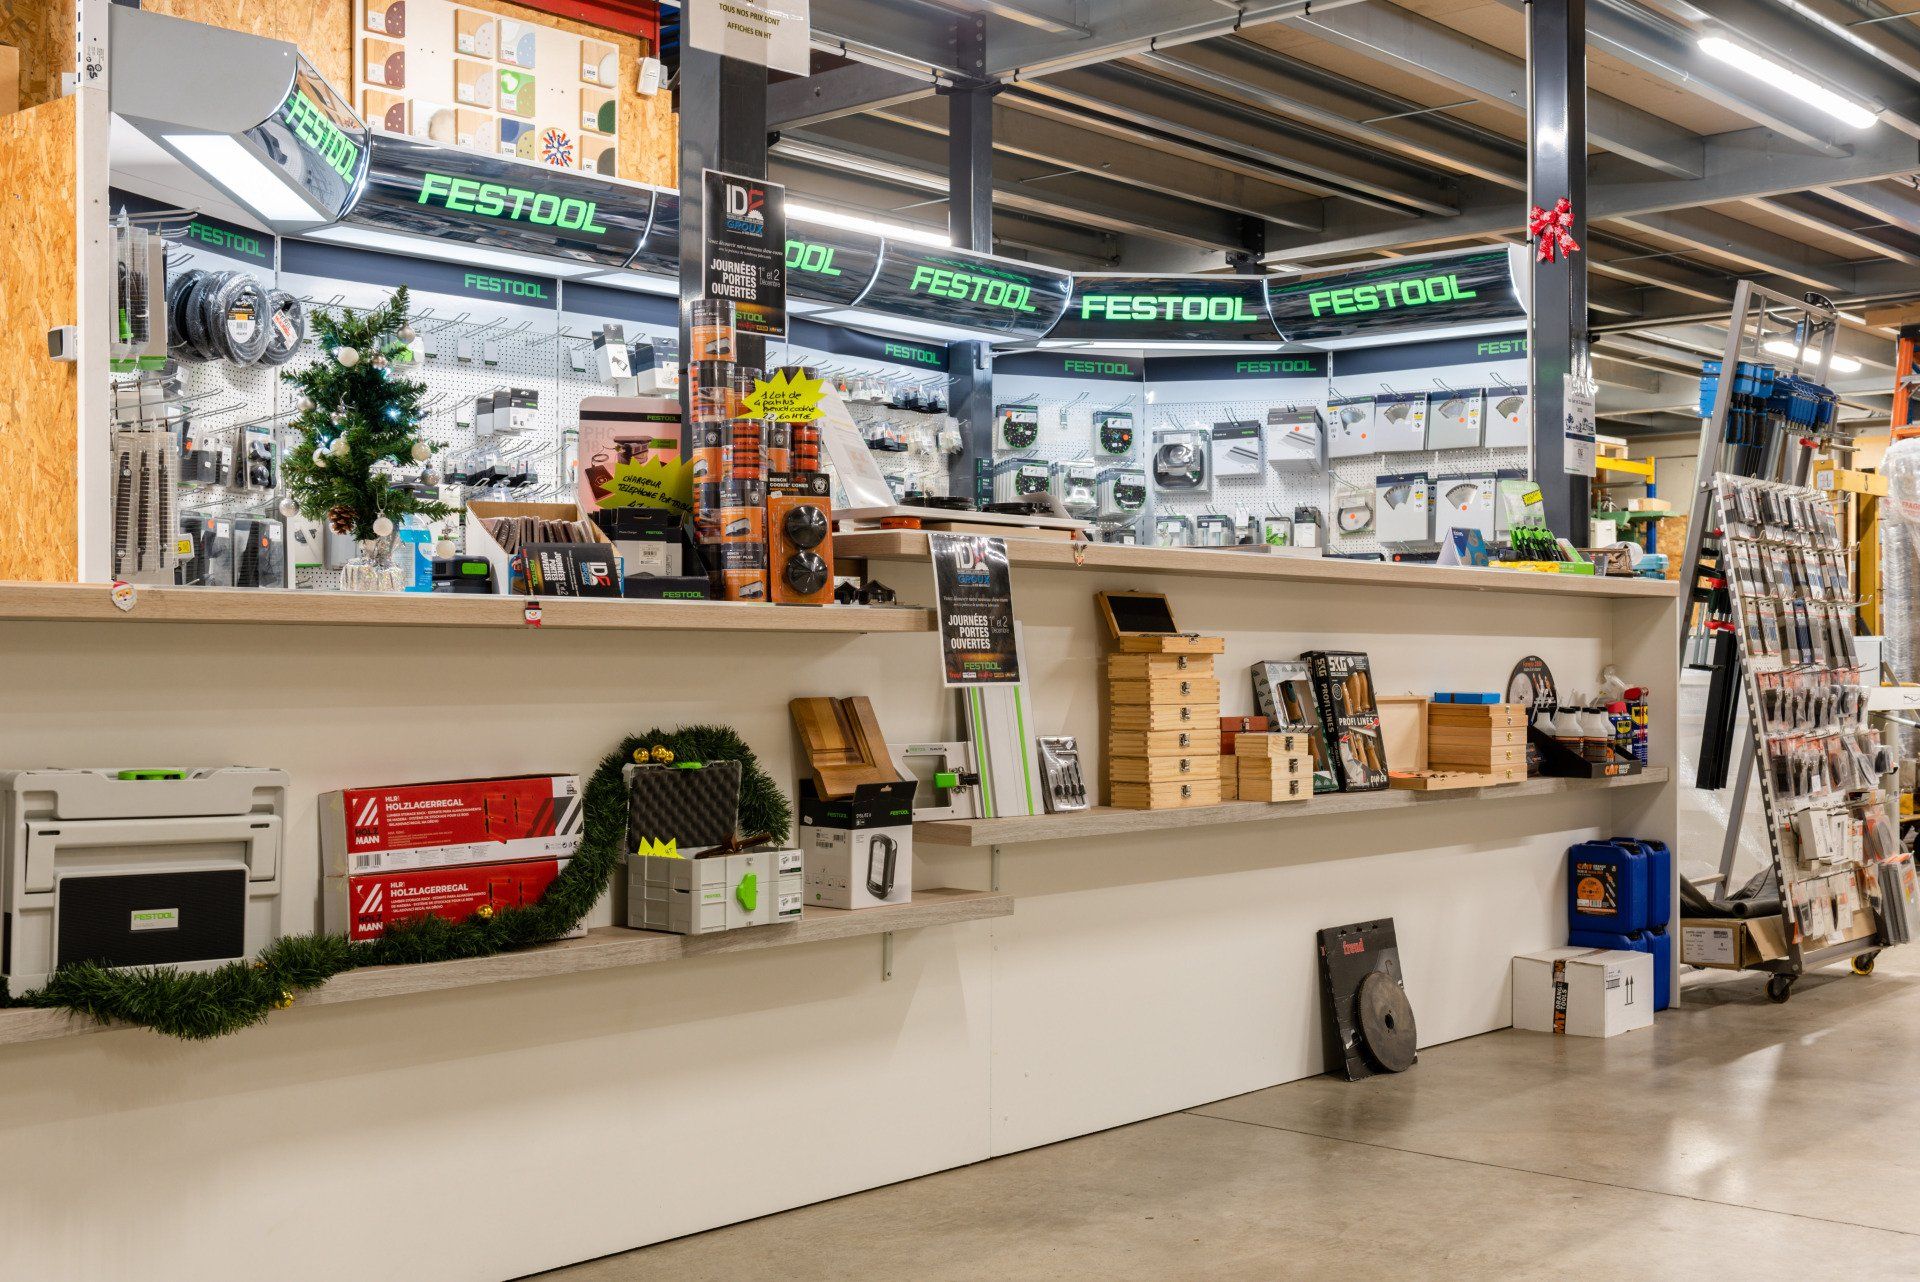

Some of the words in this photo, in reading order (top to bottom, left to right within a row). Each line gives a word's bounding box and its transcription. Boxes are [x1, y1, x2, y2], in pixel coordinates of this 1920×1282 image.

[719, 3, 736, 13] TOUS
[736, 8, 749, 18] NOS
[750, 12, 764, 21] PRIX
[764, 16, 780, 26] SONT
[727, 22, 754, 35] AFFICHES
[754, 29, 763, 37] EN
[763, 32, 772, 40] HT
[285, 89, 359, 184] FESTOOL
[418, 173, 607, 233] FESTOOL
[190, 221, 265, 257] FESTOOL
[786, 240, 841, 276] OOL
[711, 258, 757, 277] JOURNÉES
[766, 271, 773, 279] et
[773, 269, 780, 281] 2
[464, 273, 548, 299] FESTOOL
[722, 273, 757, 288] PORTES
[712, 283, 757, 300] OUVERTES
[910, 265, 1037, 312] FESTOOL
[1309, 274, 1476, 317] FESTOOL
[1082, 295, 1257, 321] FESTOOL
[885, 343, 941, 365] FESTOOL
[1064, 360, 1134, 376] FESTOOL
[1236, 359, 1317, 374] FESTOOL
[789, 390, 801, 400] de
[618, 483, 658, 498] TELEPHONE
[948, 613, 988, 627] JOURNÉES
[1002, 616, 1008, 627] 2
[960, 626, 989, 638] PORTES
[951, 637, 991, 649] OUVERTES
[964, 661, 1001, 670] FESTOOL
[1320, 683, 1330, 707] PROFI
[1325, 707, 1335, 733] LINES
[1338, 717, 1356, 726] PROFI
[1357, 716, 1374, 725] LINES
[386, 799, 464, 811] HOLZLAGERREGAL
[355, 827, 379, 836] HOLZ
[355, 835, 380, 845] MANN
[390, 883, 468, 898] HOLZLAGERREGAL
[133, 912, 176, 920] FESTOOL
[358, 914, 382, 922] HOLZ
[358, 922, 383, 932] MANN
[1343, 937, 1365, 955] freud
[1560, 988, 1568, 1010] TOOLS
